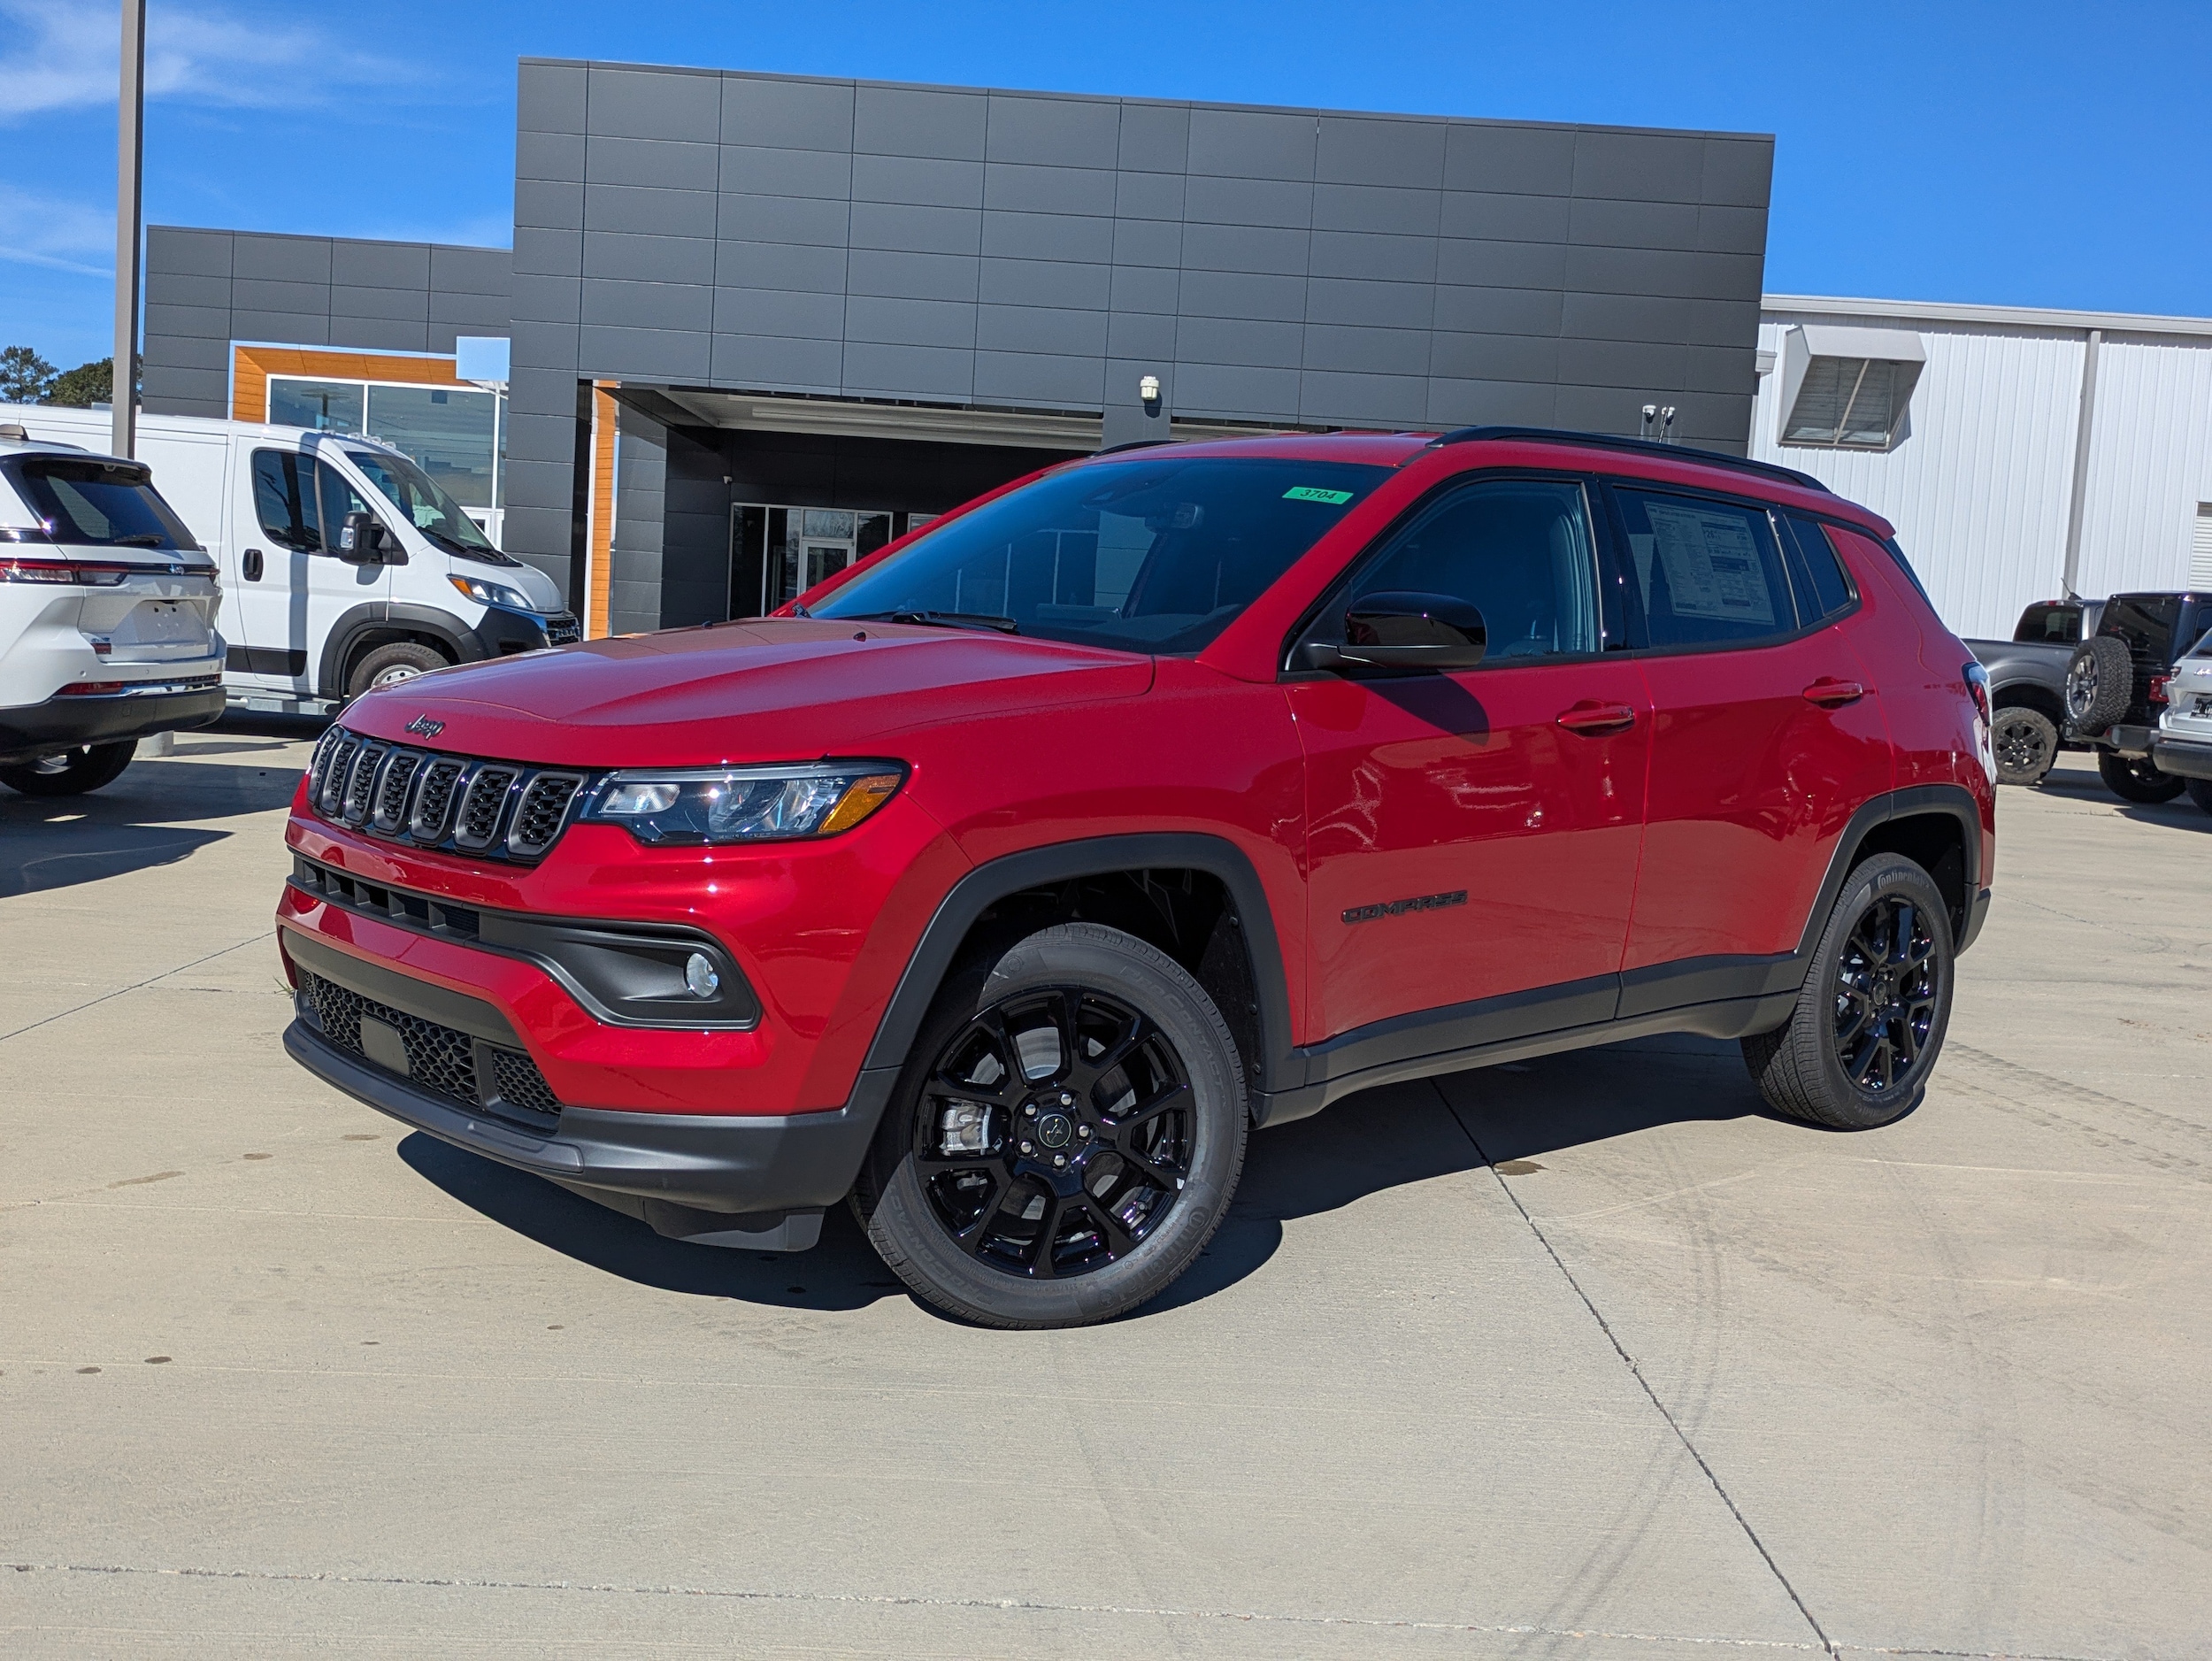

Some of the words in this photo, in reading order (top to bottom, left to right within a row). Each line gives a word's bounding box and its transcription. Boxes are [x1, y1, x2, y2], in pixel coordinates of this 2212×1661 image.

[1300, 488, 1338, 500] 3704
[404, 713, 446, 741] Jeep
[1340, 889, 1468, 924] COMPASS
